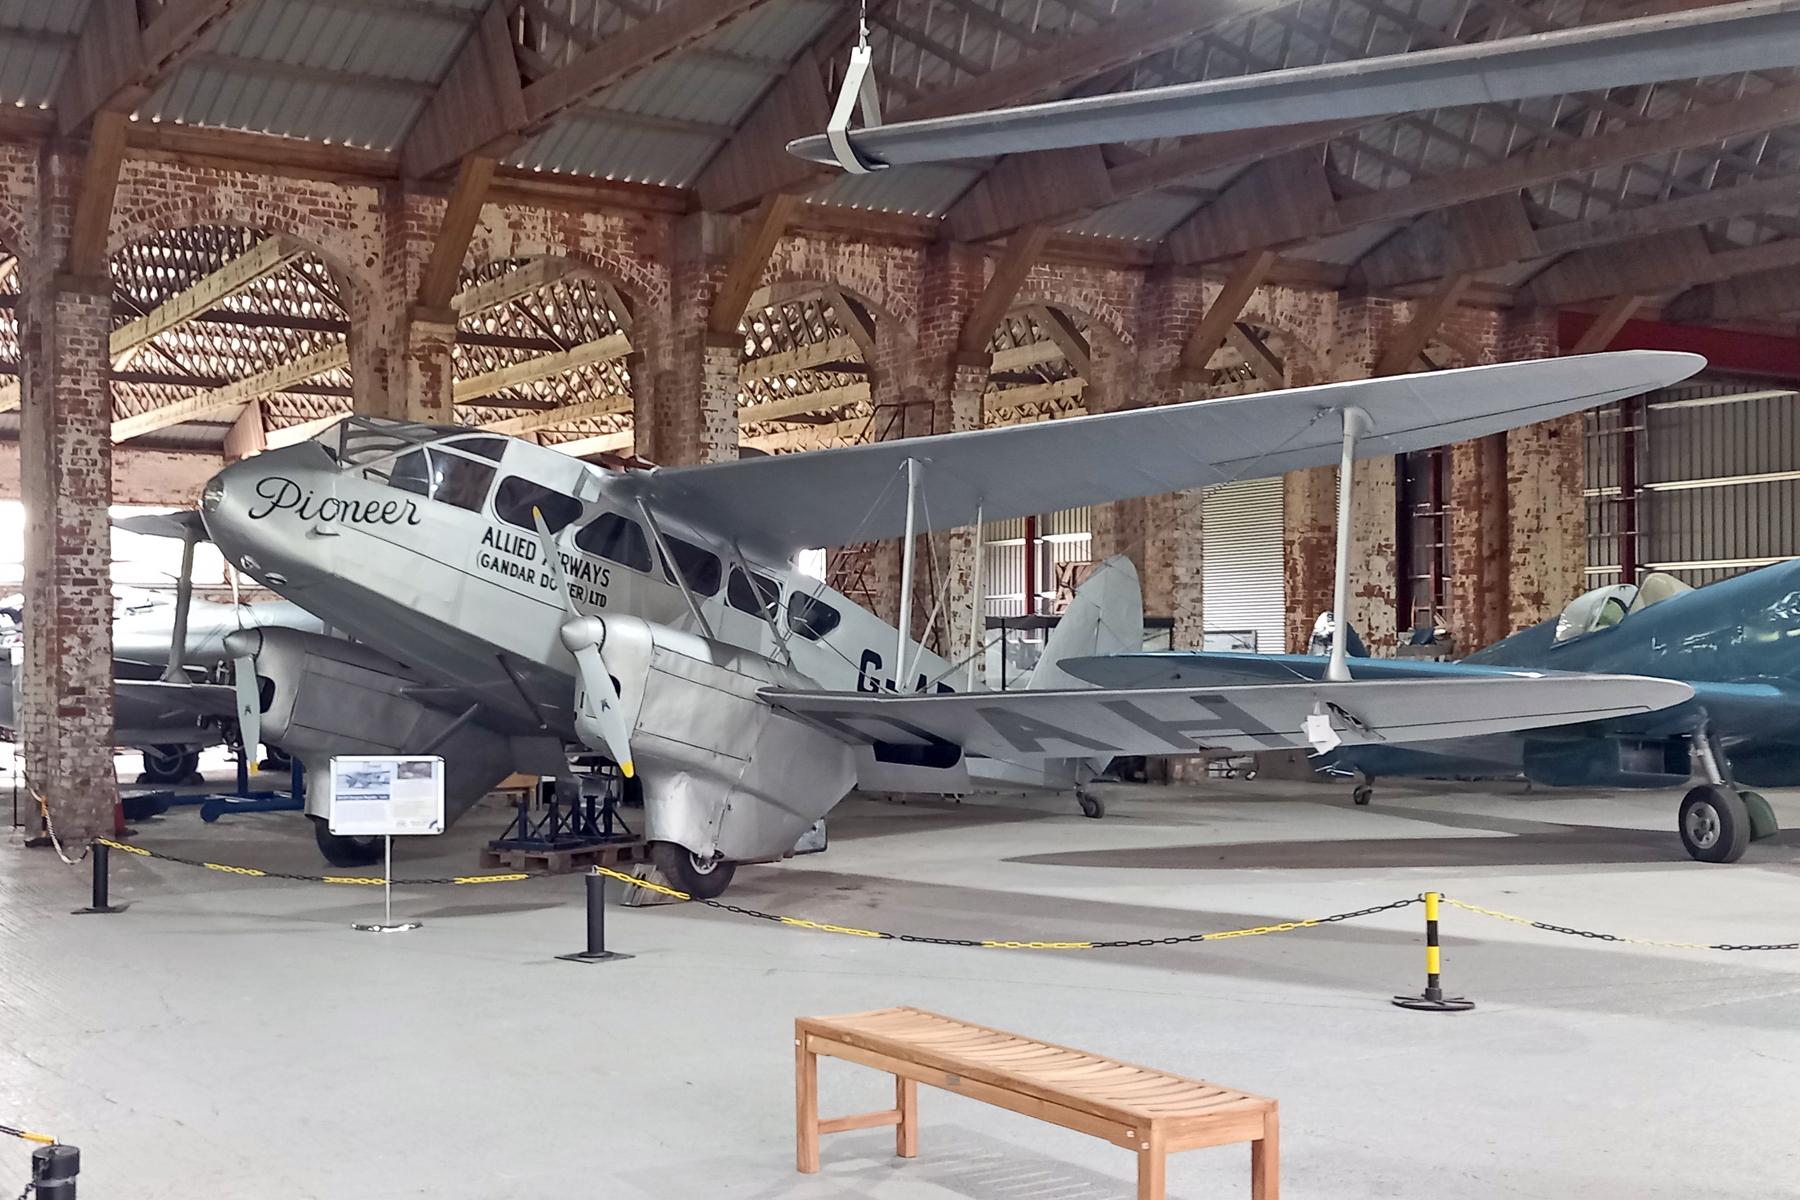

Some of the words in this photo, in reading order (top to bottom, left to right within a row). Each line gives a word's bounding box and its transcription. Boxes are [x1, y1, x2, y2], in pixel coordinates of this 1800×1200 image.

[248, 476, 421, 526] Pioneer
[476, 550, 535, 585] (GANDAR
[540, 573, 588, 605] DOER)
[589, 590, 608, 608] LTD
[481, 526, 537, 561] ALLIED
[541, 551, 611, 588] RWAYS
